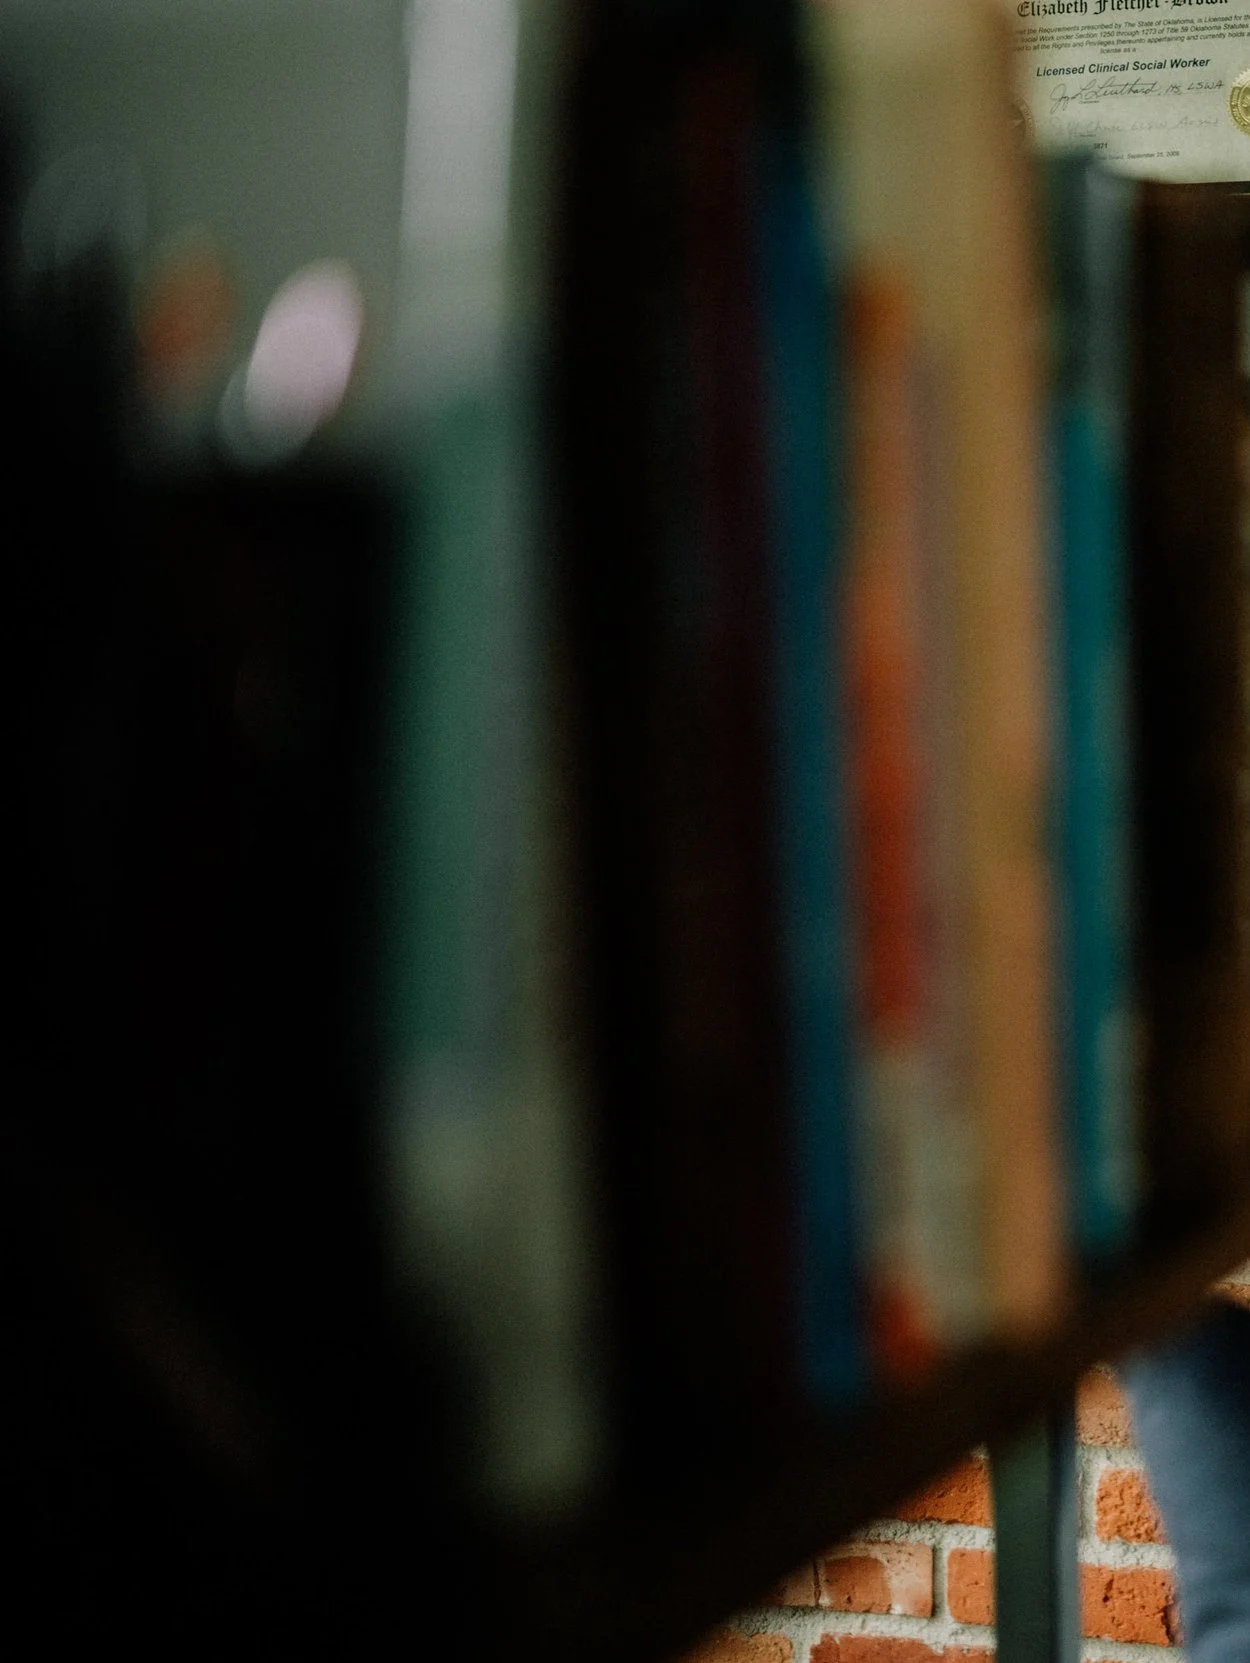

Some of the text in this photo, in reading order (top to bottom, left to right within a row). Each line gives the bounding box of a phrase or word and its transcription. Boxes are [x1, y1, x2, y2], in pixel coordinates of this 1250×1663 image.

[1017, 0, 1087, 17] Elizabeth
[1190, 24, 1221, 32] Oklahoma
[1036, 57, 1211, 77] Licensed Clinical Social Worker
